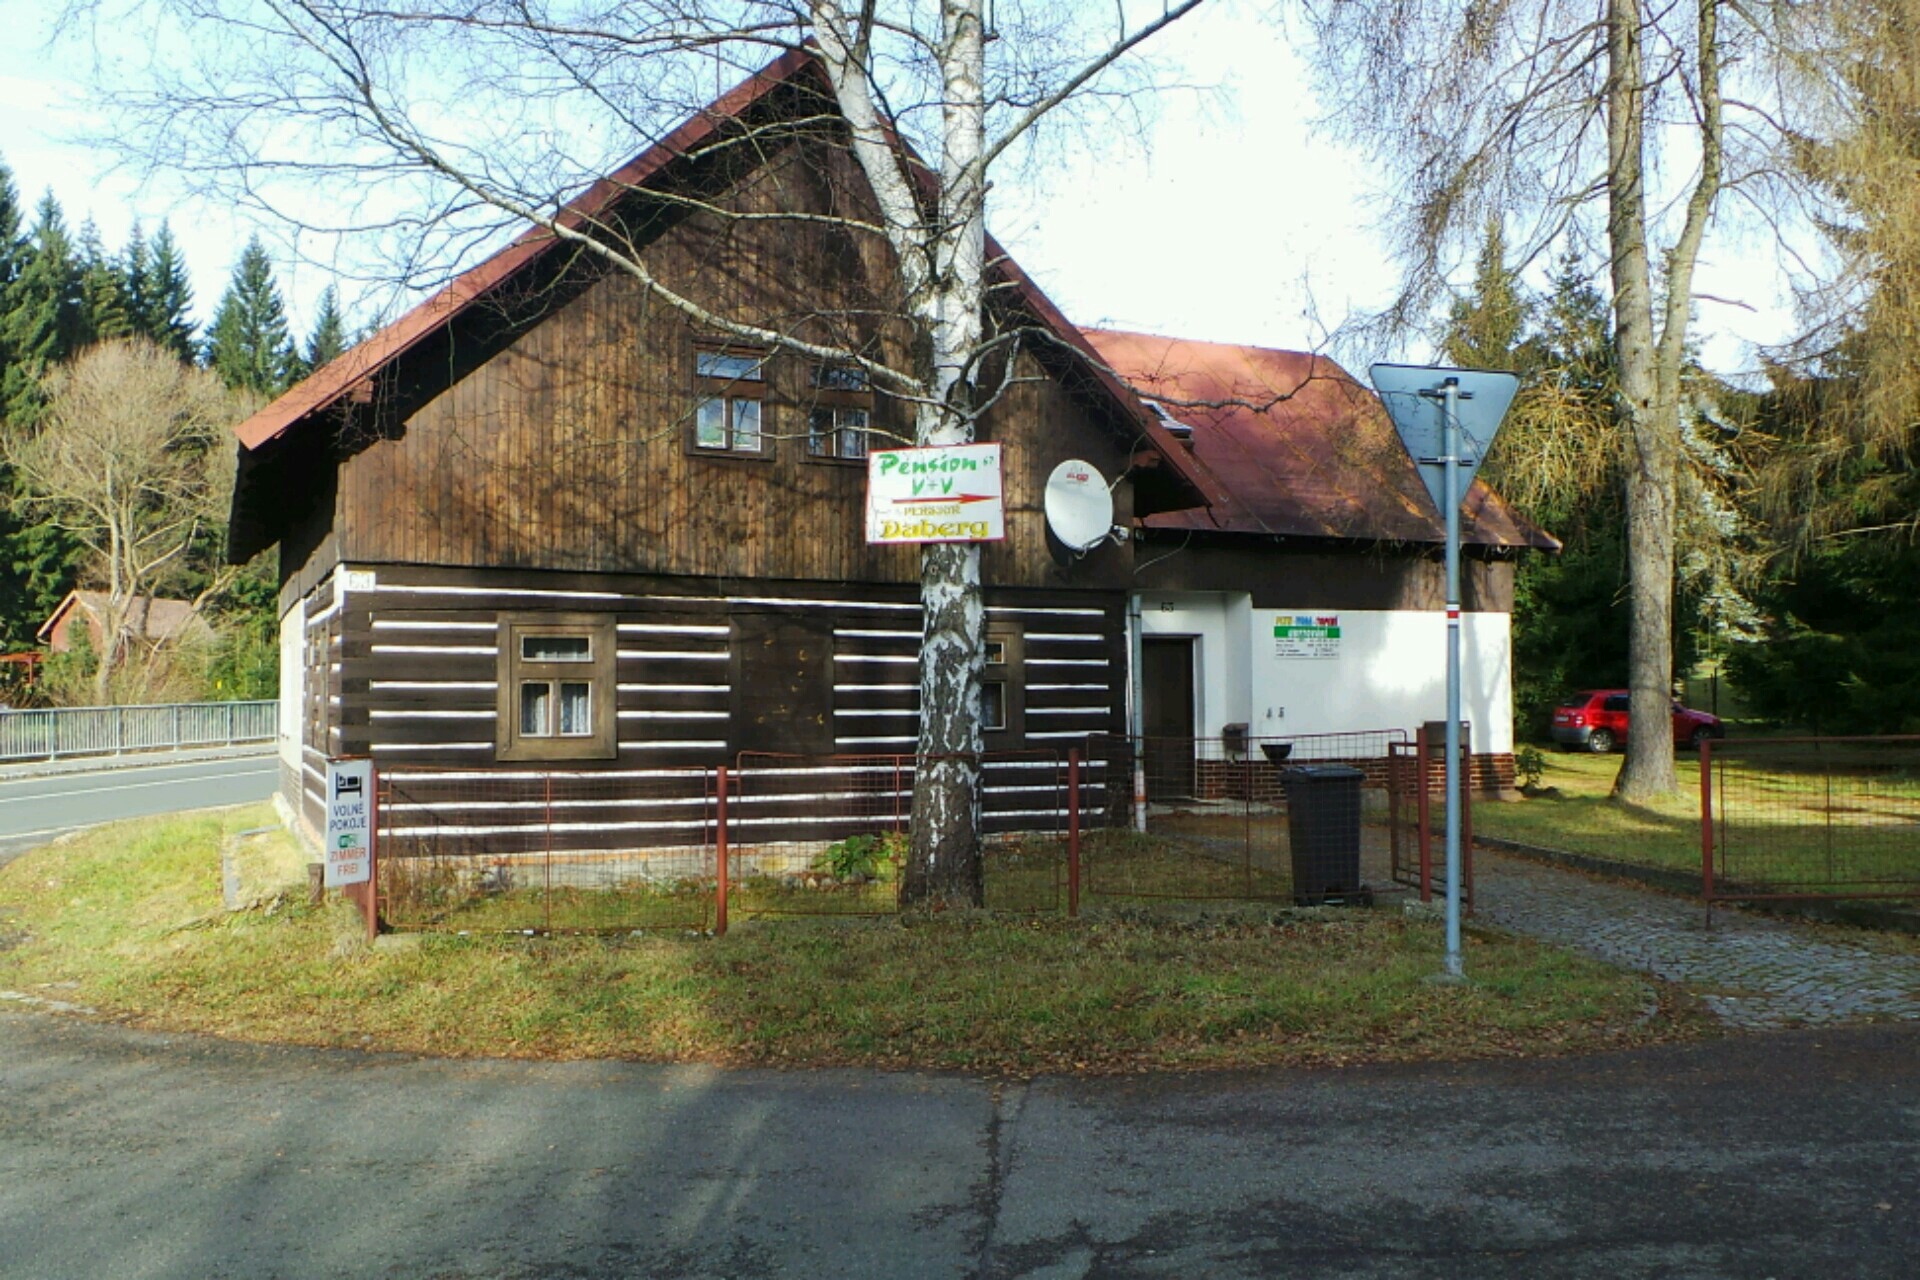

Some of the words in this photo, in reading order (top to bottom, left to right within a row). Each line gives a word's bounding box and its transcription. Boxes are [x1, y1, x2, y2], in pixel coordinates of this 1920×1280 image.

[878, 453, 977, 476] Pension
[879, 519, 989, 539] Daberg
[329, 816, 367, 832] POKOJE
[329, 847, 366, 863] ZIMMER
[337, 863, 358, 876] FREI
